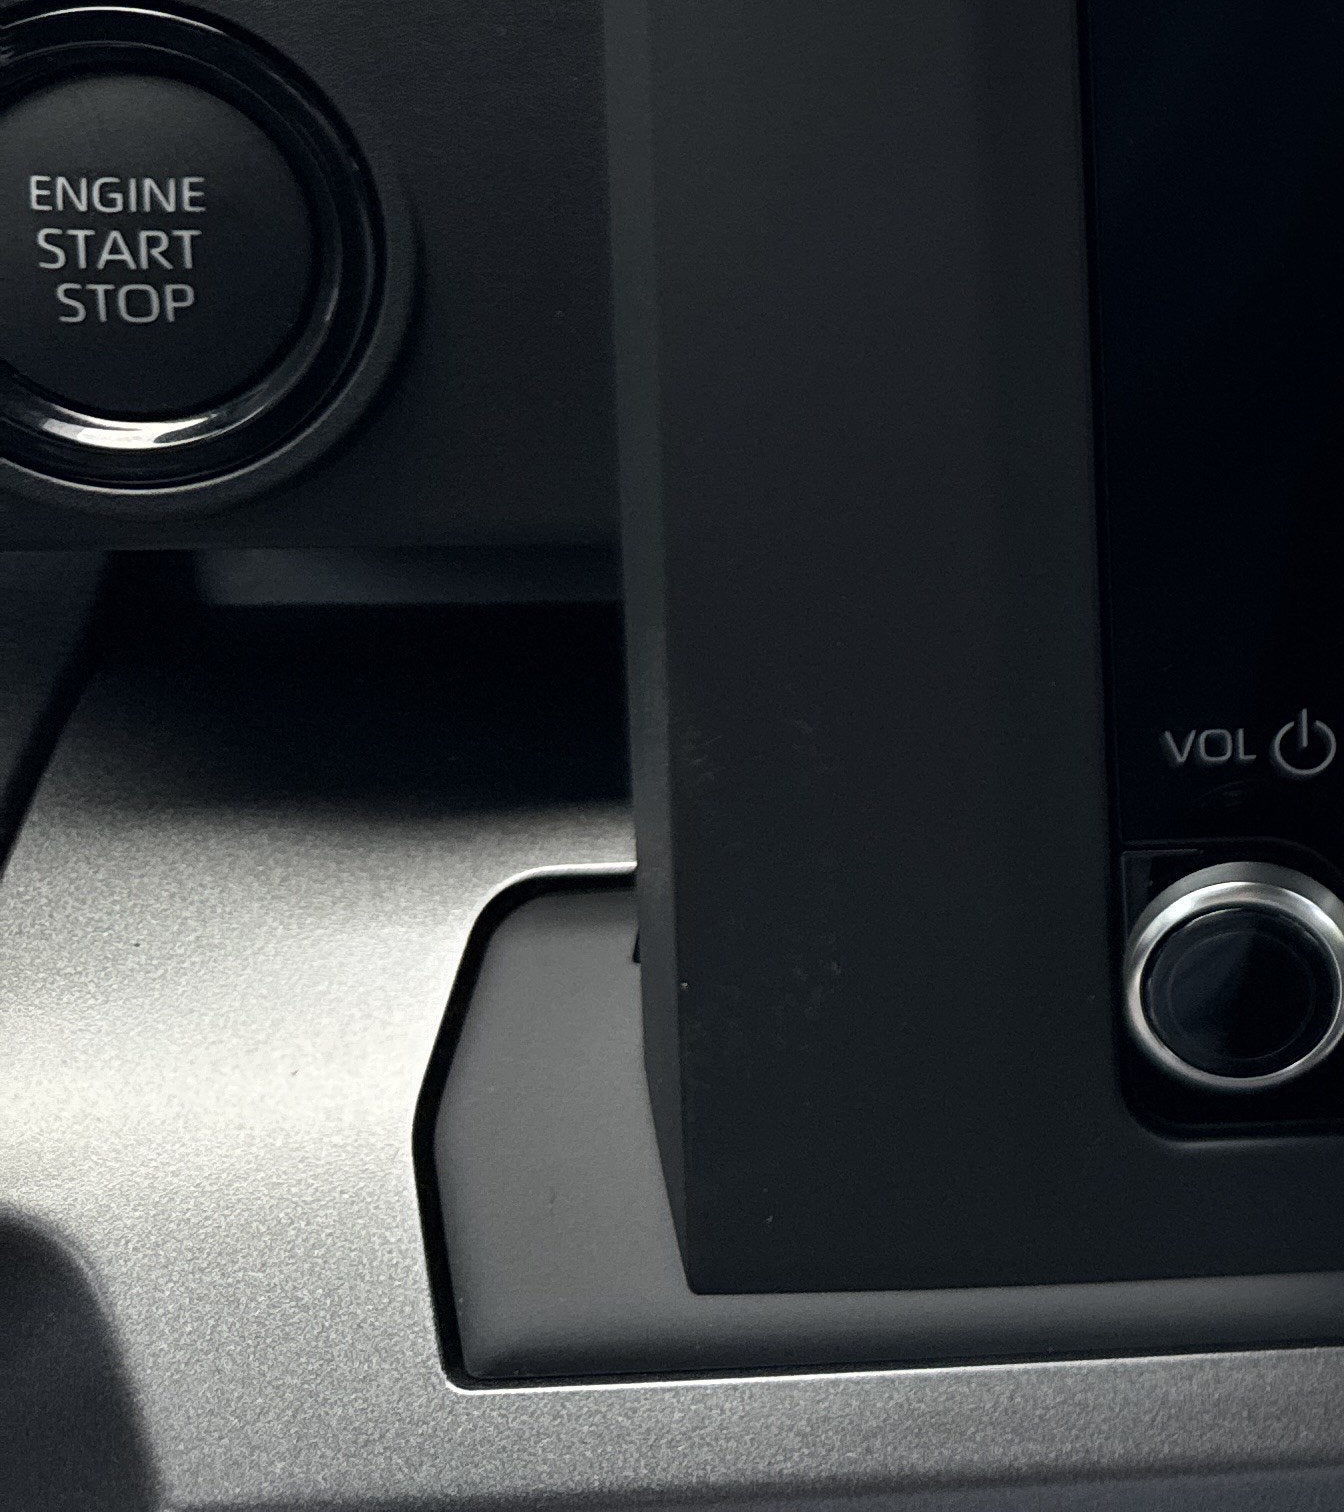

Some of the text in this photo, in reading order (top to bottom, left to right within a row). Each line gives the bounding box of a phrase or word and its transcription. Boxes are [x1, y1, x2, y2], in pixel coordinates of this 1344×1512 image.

[29, 175, 206, 213] ENGINE
[36, 228, 202, 269] START
[56, 284, 195, 323] STOP
[1162, 728, 1257, 764] VOL
